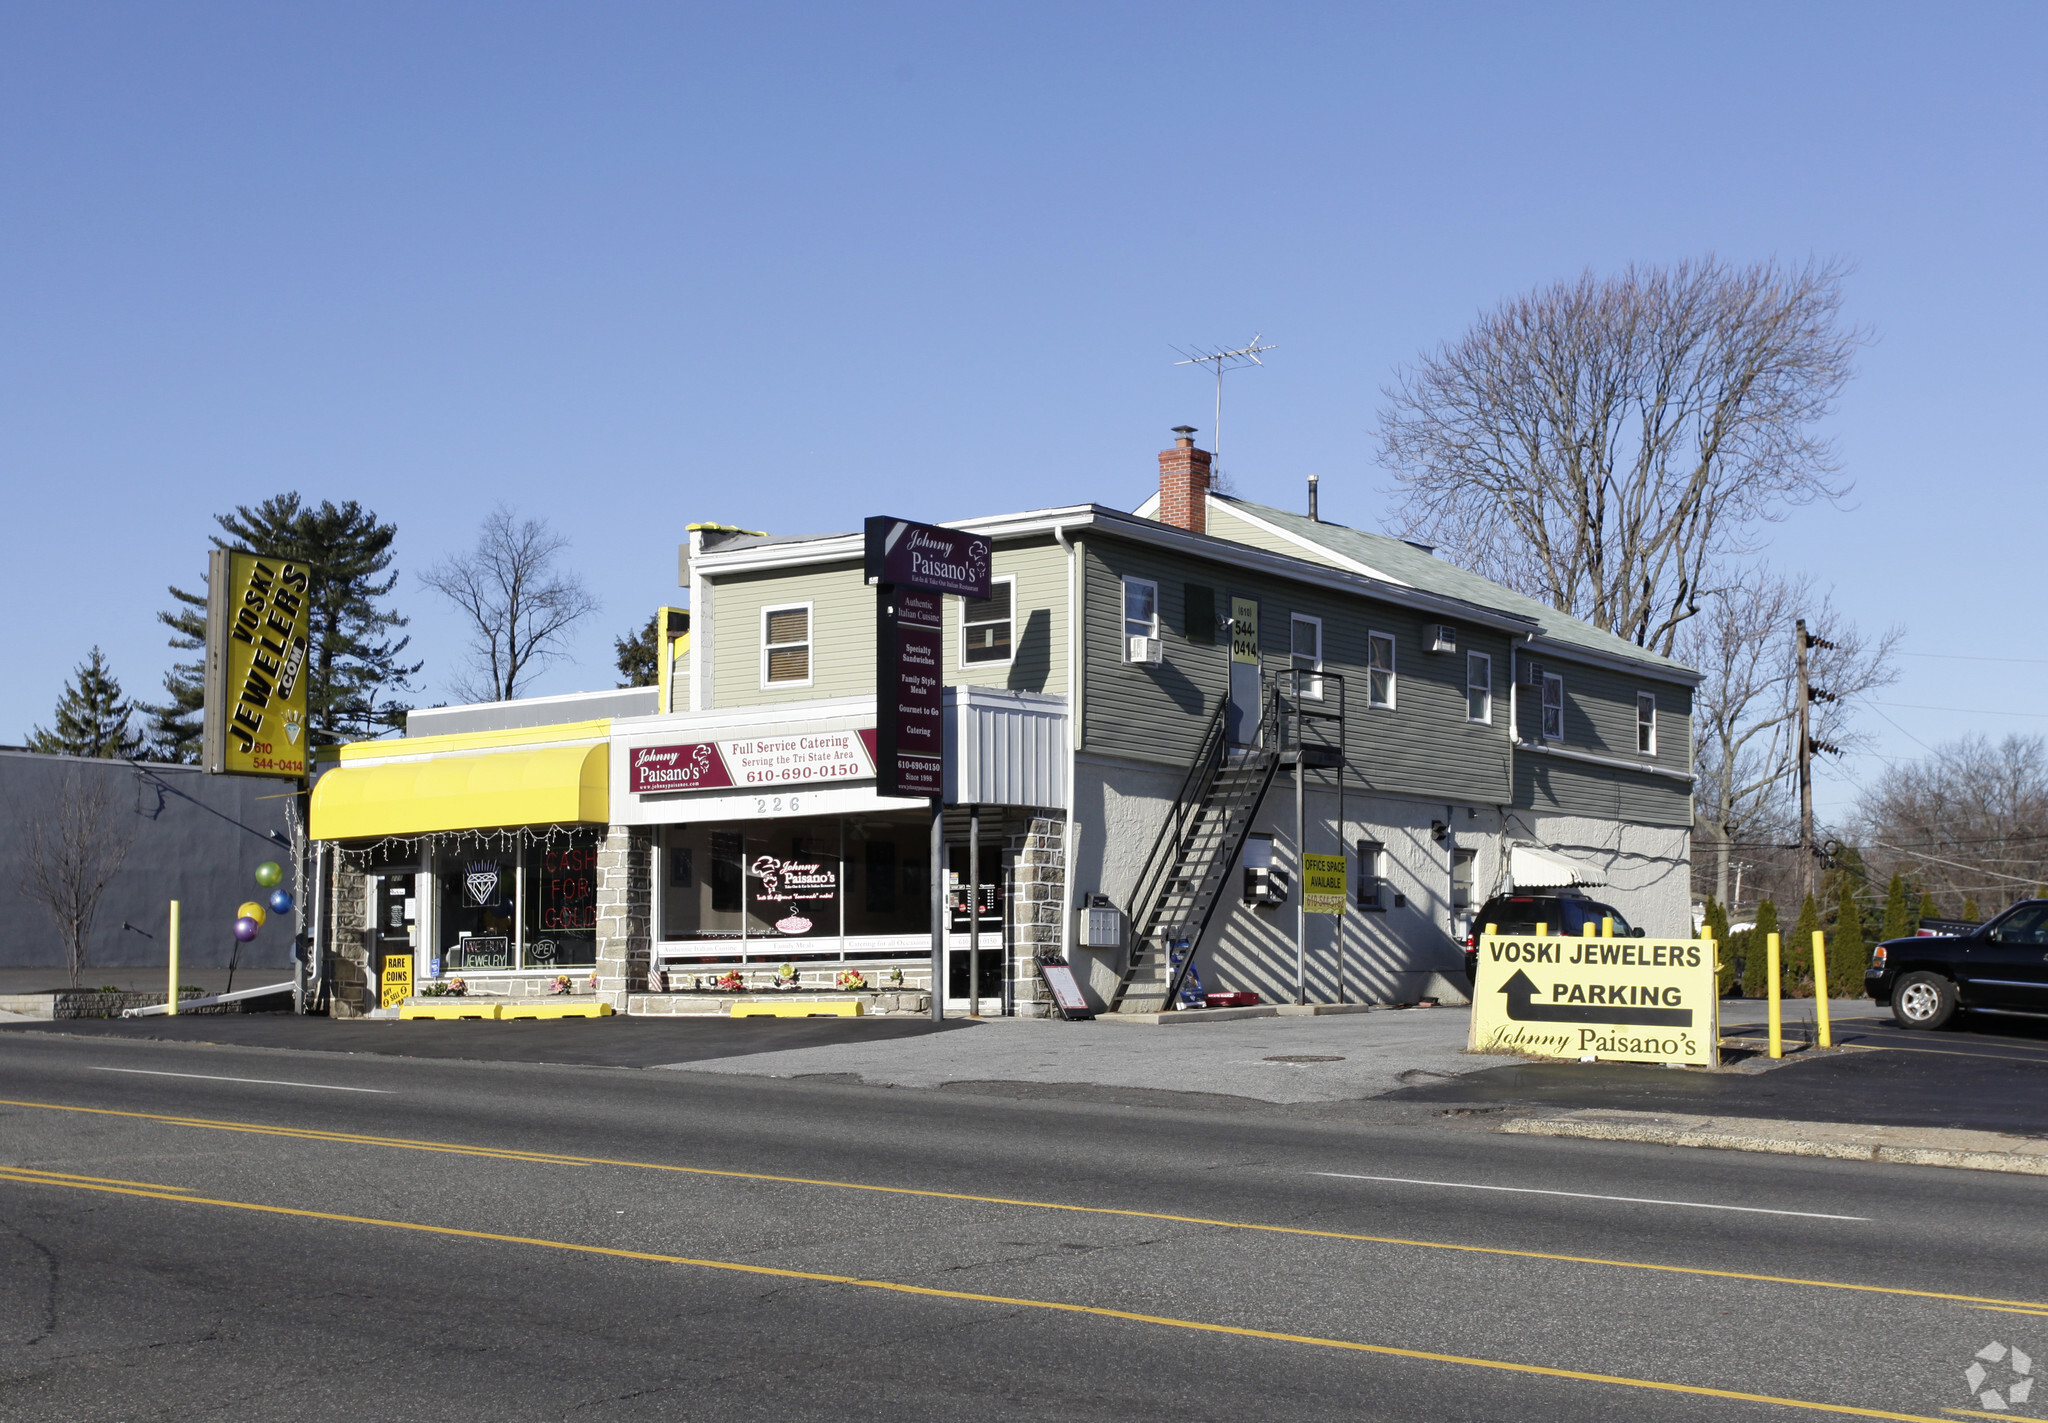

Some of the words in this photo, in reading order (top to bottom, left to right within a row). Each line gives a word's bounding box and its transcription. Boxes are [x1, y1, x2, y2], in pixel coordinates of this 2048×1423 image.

[906, 529, 954, 558] Johnny
[912, 552, 976, 582] Paisano's
[232, 560, 276, 645] VOSKI
[904, 597, 932, 610] Authentic
[898, 608, 916, 619] Italian
[918, 610, 940, 622] Cuisine
[1235, 620, 1255, 636] 544-
[906, 644, 931, 656] Specialty
[1234, 640, 1256, 658] 0414
[228, 563, 308, 754] JEWELERS
[902, 654, 934, 665] Sandwiches
[902, 674, 920, 686] Family
[922, 676, 936, 686] Style
[910, 685, 927, 695] Meals
[899, 704, 922, 714] Gourmet
[924, 707, 930, 715] to
[930, 708, 939, 716] Go
[906, 726, 931, 737] Catering
[254, 742, 272, 755] 610
[732, 741, 754, 756] Full
[756, 741, 796, 754] Service
[800, 736, 848, 751] Catering
[253, 757, 303, 772] 544-0414
[634, 748, 680, 767] Johnny
[742, 756, 774, 768] Serving
[776, 755, 790, 765] the
[792, 753, 806, 764] Tri
[808, 752, 831, 763] State
[834, 750, 854, 760] Area
[746, 763, 859, 783] 610-690-0150
[898, 760, 940, 772] 610-690-0150
[640, 763, 700, 784] Paisano's
[906, 772, 919, 781] Since
[546, 850, 596, 872] CASH
[779, 860, 820, 875] Johnny
[1305, 860, 1326, 872] OFFICE
[1326, 862, 1345, 873] SPACE
[784, 870, 836, 884] Paisano's
[1310, 876, 1342, 888] AVAILABLE
[552, 878, 588, 899] FOR
[545, 906, 596, 928] GOLD
[466, 940, 481, 952] WE
[485, 940, 506, 952] BUY
[532, 942, 556, 956] OPEN
[466, 954, 506, 968] JEWELRY
[1490, 942, 1560, 964] VOSKI
[1570, 944, 1701, 967] JEWELERS
[388, 958, 406, 968] RARE
[386, 971, 407, 982] COINS
[383, 987, 392, 997] BUY
[390, 992, 400, 1002] SELL
[1553, 984, 1682, 1006] PARKING
[1488, 1024, 1574, 1054] Johnny
[1578, 1028, 1696, 1056] Paisano's
